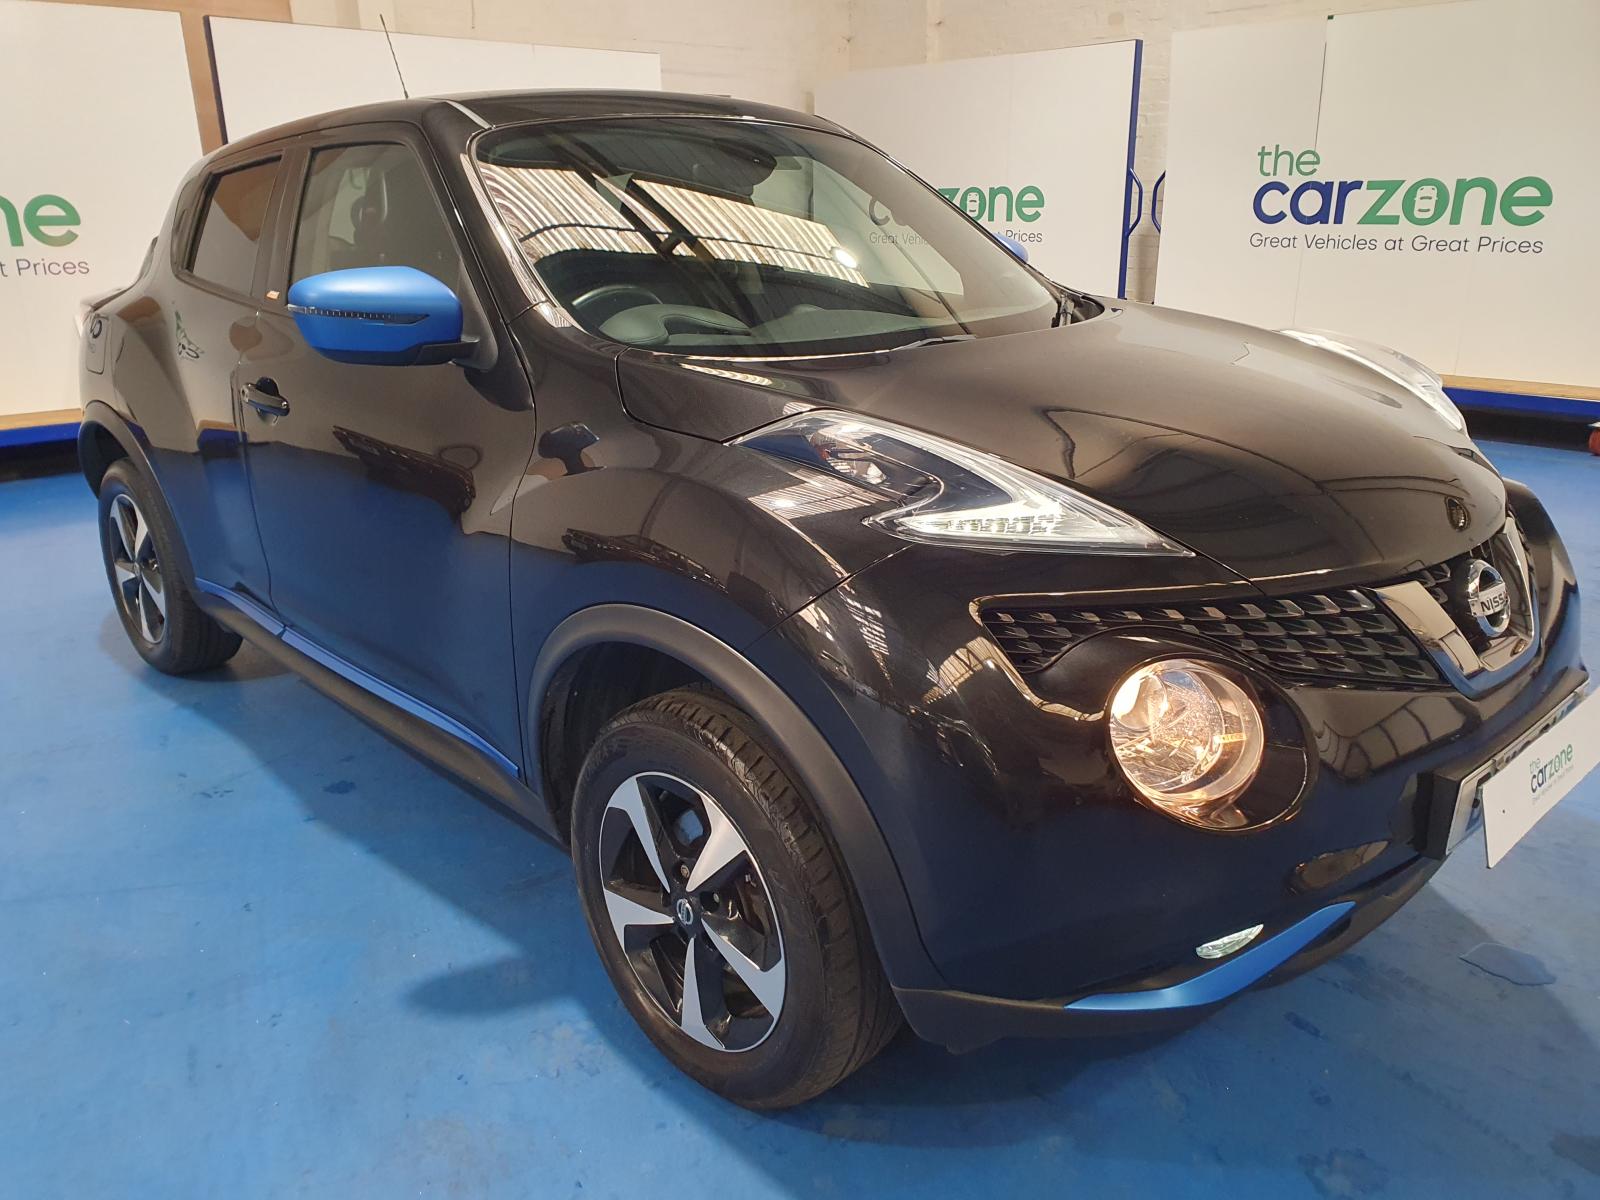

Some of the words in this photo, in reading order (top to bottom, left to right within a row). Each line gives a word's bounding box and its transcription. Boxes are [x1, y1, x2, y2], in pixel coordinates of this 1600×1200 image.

[1257, 144, 1321, 177] the
[1252, 176, 1553, 226] carzone
[1005, 229, 1043, 243] Prices
[1249, 232, 1298, 249] Great
[1304, 233, 1378, 251] Vehicles
[1384, 237, 1405, 251] at
[1411, 234, 1470, 252] Great
[1477, 236, 1544, 254] Prices
[16, 258, 90, 276] Prices
[1480, 592, 1508, 613] NISS
[1531, 743, 1574, 793] carzone
